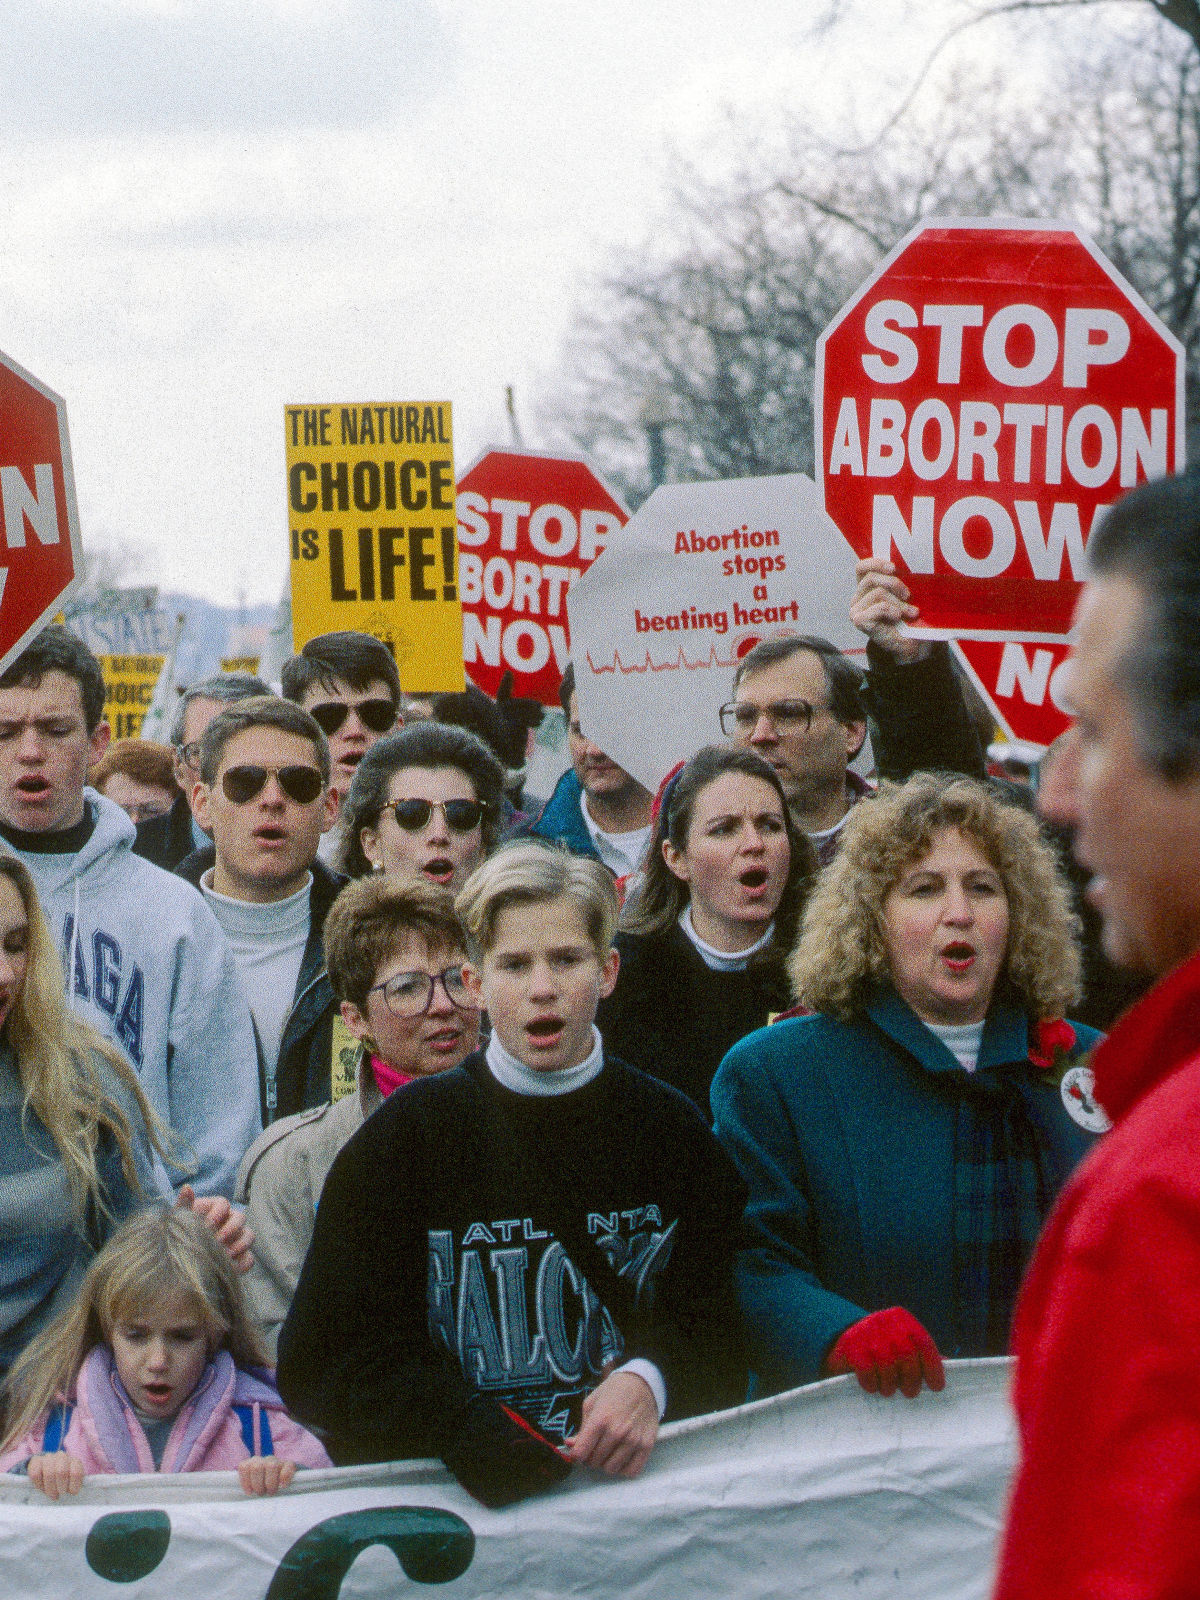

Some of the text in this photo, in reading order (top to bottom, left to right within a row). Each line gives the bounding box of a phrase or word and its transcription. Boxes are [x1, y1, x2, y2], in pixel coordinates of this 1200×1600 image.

[861, 299, 1131, 388] STOP
[288, 406, 449, 447] THE NATURAL
[829, 397, 1168, 489] ABORTION
[289, 459, 454, 514] CHOICE
[455, 491, 623, 561] STOP
[674, 524, 781, 555] Abortion
[872, 494, 1116, 583] NOW
[292, 527, 457, 602] IS LIFE!
[722, 554, 788, 580] stops
[634, 600, 800, 635] beating heart
[752, 584, 769, 602] a
